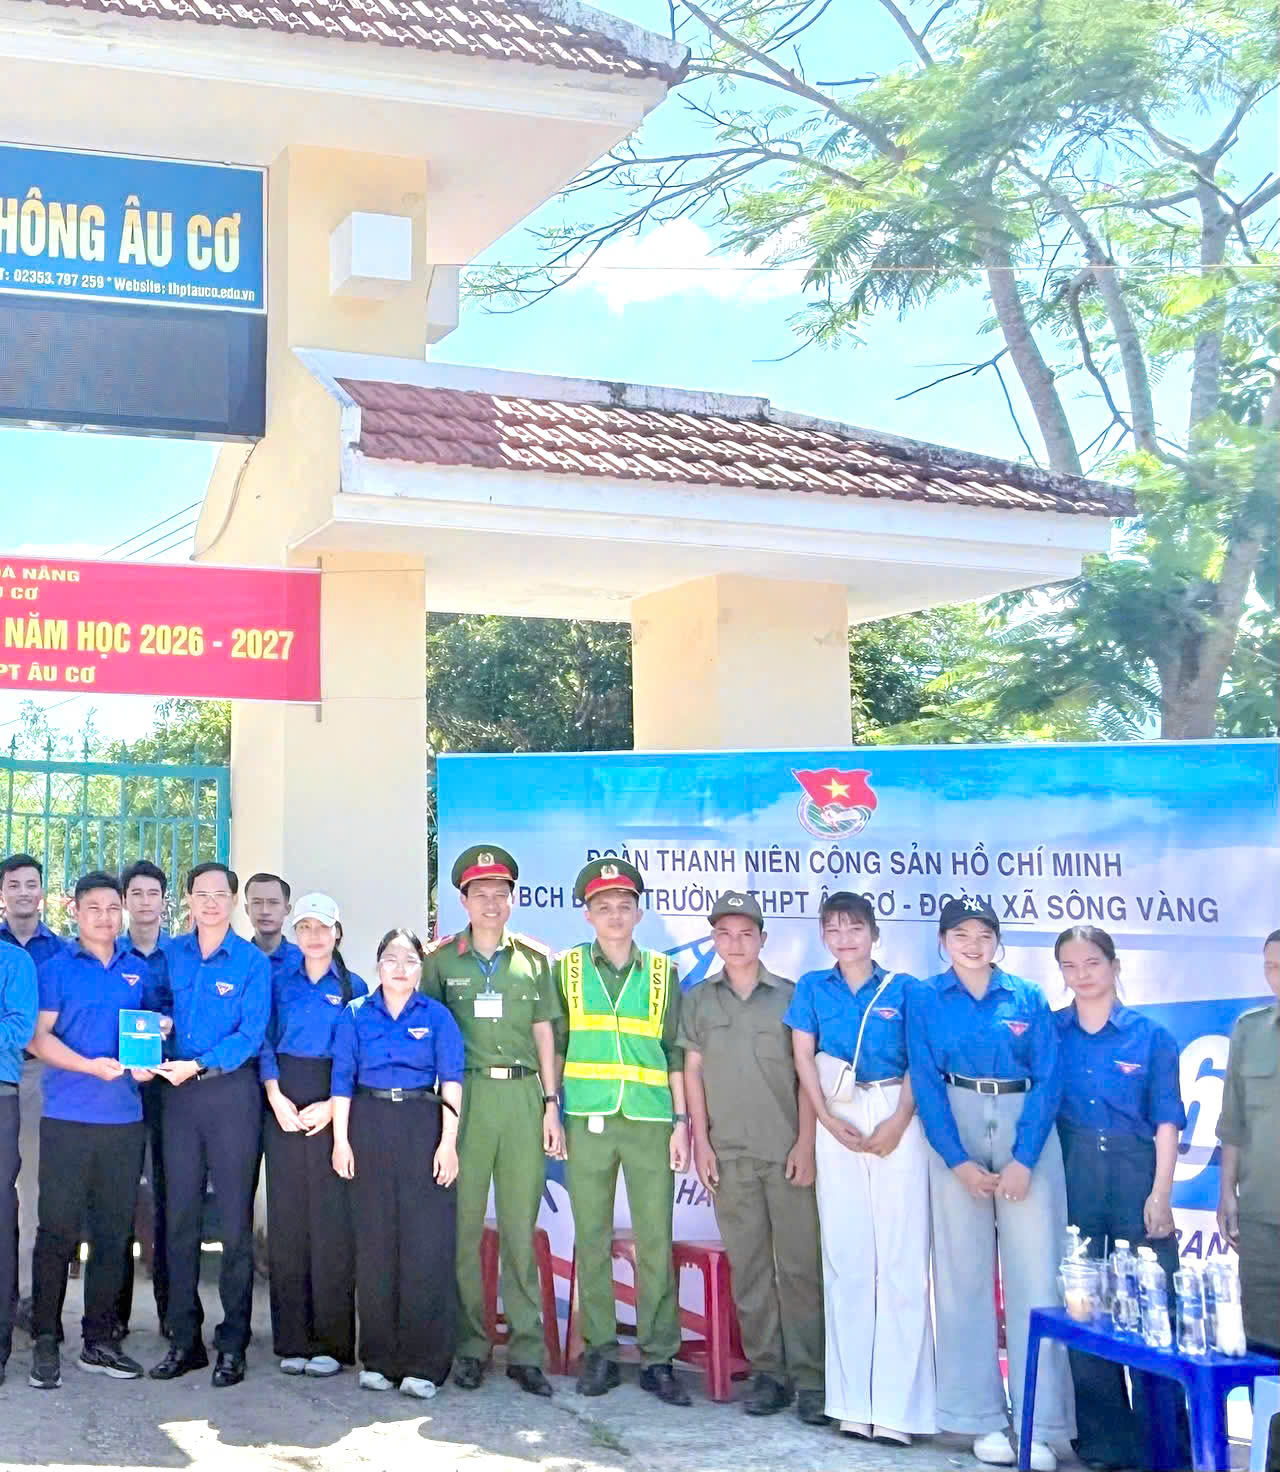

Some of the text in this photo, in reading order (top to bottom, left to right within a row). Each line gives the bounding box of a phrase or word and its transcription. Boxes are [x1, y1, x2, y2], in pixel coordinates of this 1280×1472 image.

[118, 194, 174, 268] ÂU
[186, 211, 242, 274] CƠ
[113, 276, 167, 296] Website:
[167, 281, 257, 303] thptauco.edu.vn
[10, 585, 41, 601] CƠ
[4, 611, 70, 652] NĂM
[77, 620, 132, 659] HỌC
[140, 624, 204, 657] 2026
[231, 629, 295, 661] 2027
[27, 660, 58, 682] ÂU
[64, 664, 96, 684] CƠ
[656, 849, 736, 873] THANH
[744, 844, 801, 874] NIÊN
[809, 845, 881, 879] CỘNG
[890, 842, 942, 876] SẢN
[951, 842, 989, 877] HỒ
[997, 845, 1043, 877] CHÍ
[1052, 852, 1122, 878] MINH
[519, 886, 564, 908] BCH
[642, 882, 736, 912] TRƯỜN
[1002, 888, 1039, 920] XÃ
[1047, 889, 1127, 922] SÔNG
[1136, 891, 1219, 923] VÀNG
